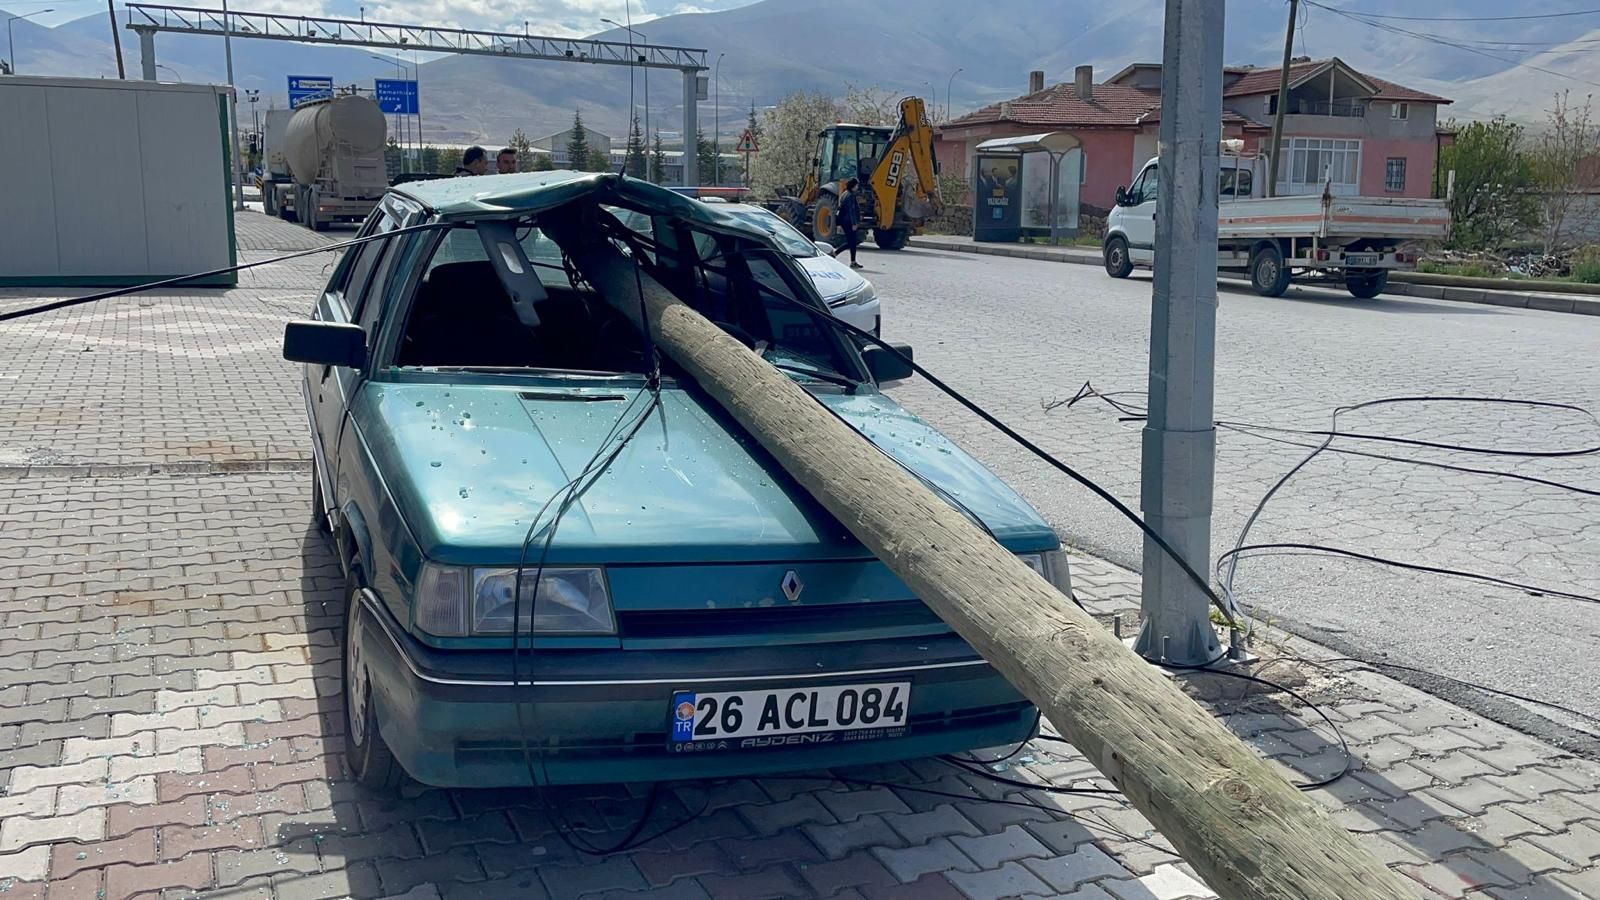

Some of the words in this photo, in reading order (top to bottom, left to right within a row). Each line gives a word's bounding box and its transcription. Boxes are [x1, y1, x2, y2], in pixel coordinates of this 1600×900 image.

[887, 152, 903, 187] JCB
[675, 721, 692, 733] TR
[694, 695, 744, 736] 26
[757, 691, 829, 731] ACL
[836, 686, 904, 726] 084
